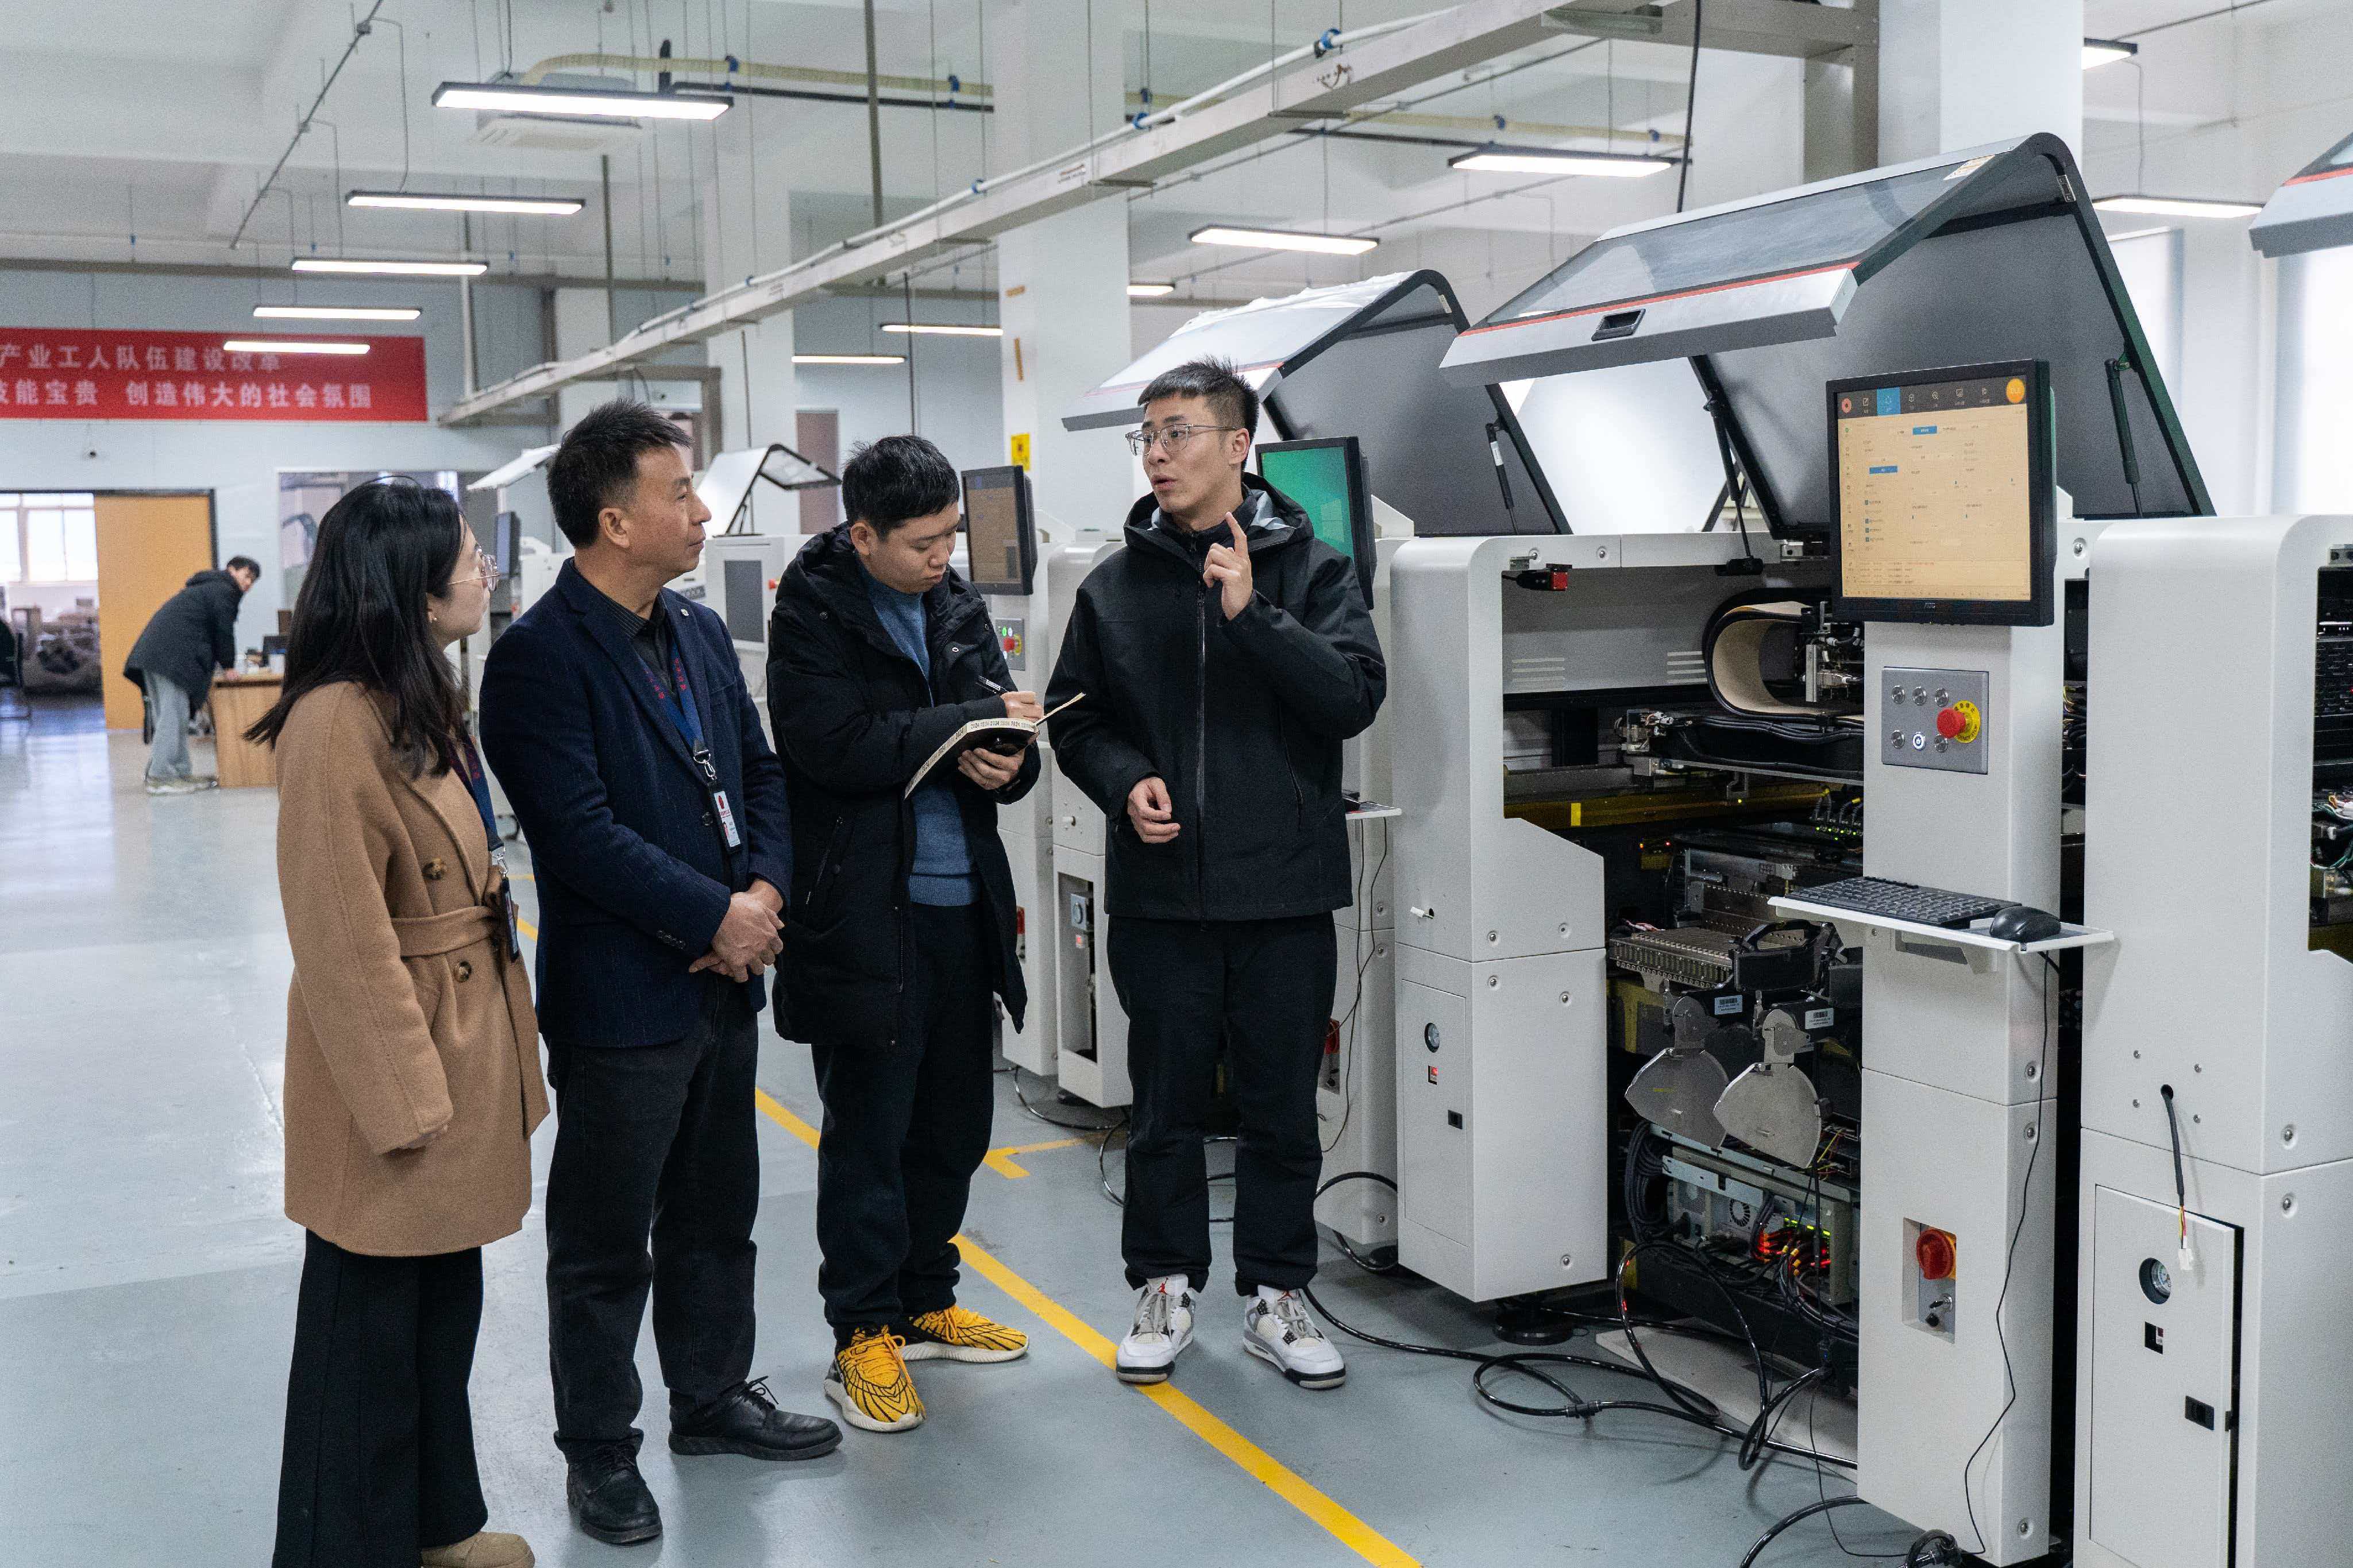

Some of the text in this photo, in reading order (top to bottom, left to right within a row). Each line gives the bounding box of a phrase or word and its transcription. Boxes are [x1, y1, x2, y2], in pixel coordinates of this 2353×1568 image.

[126, 381, 371, 408] 创造伟大的社会氛围
